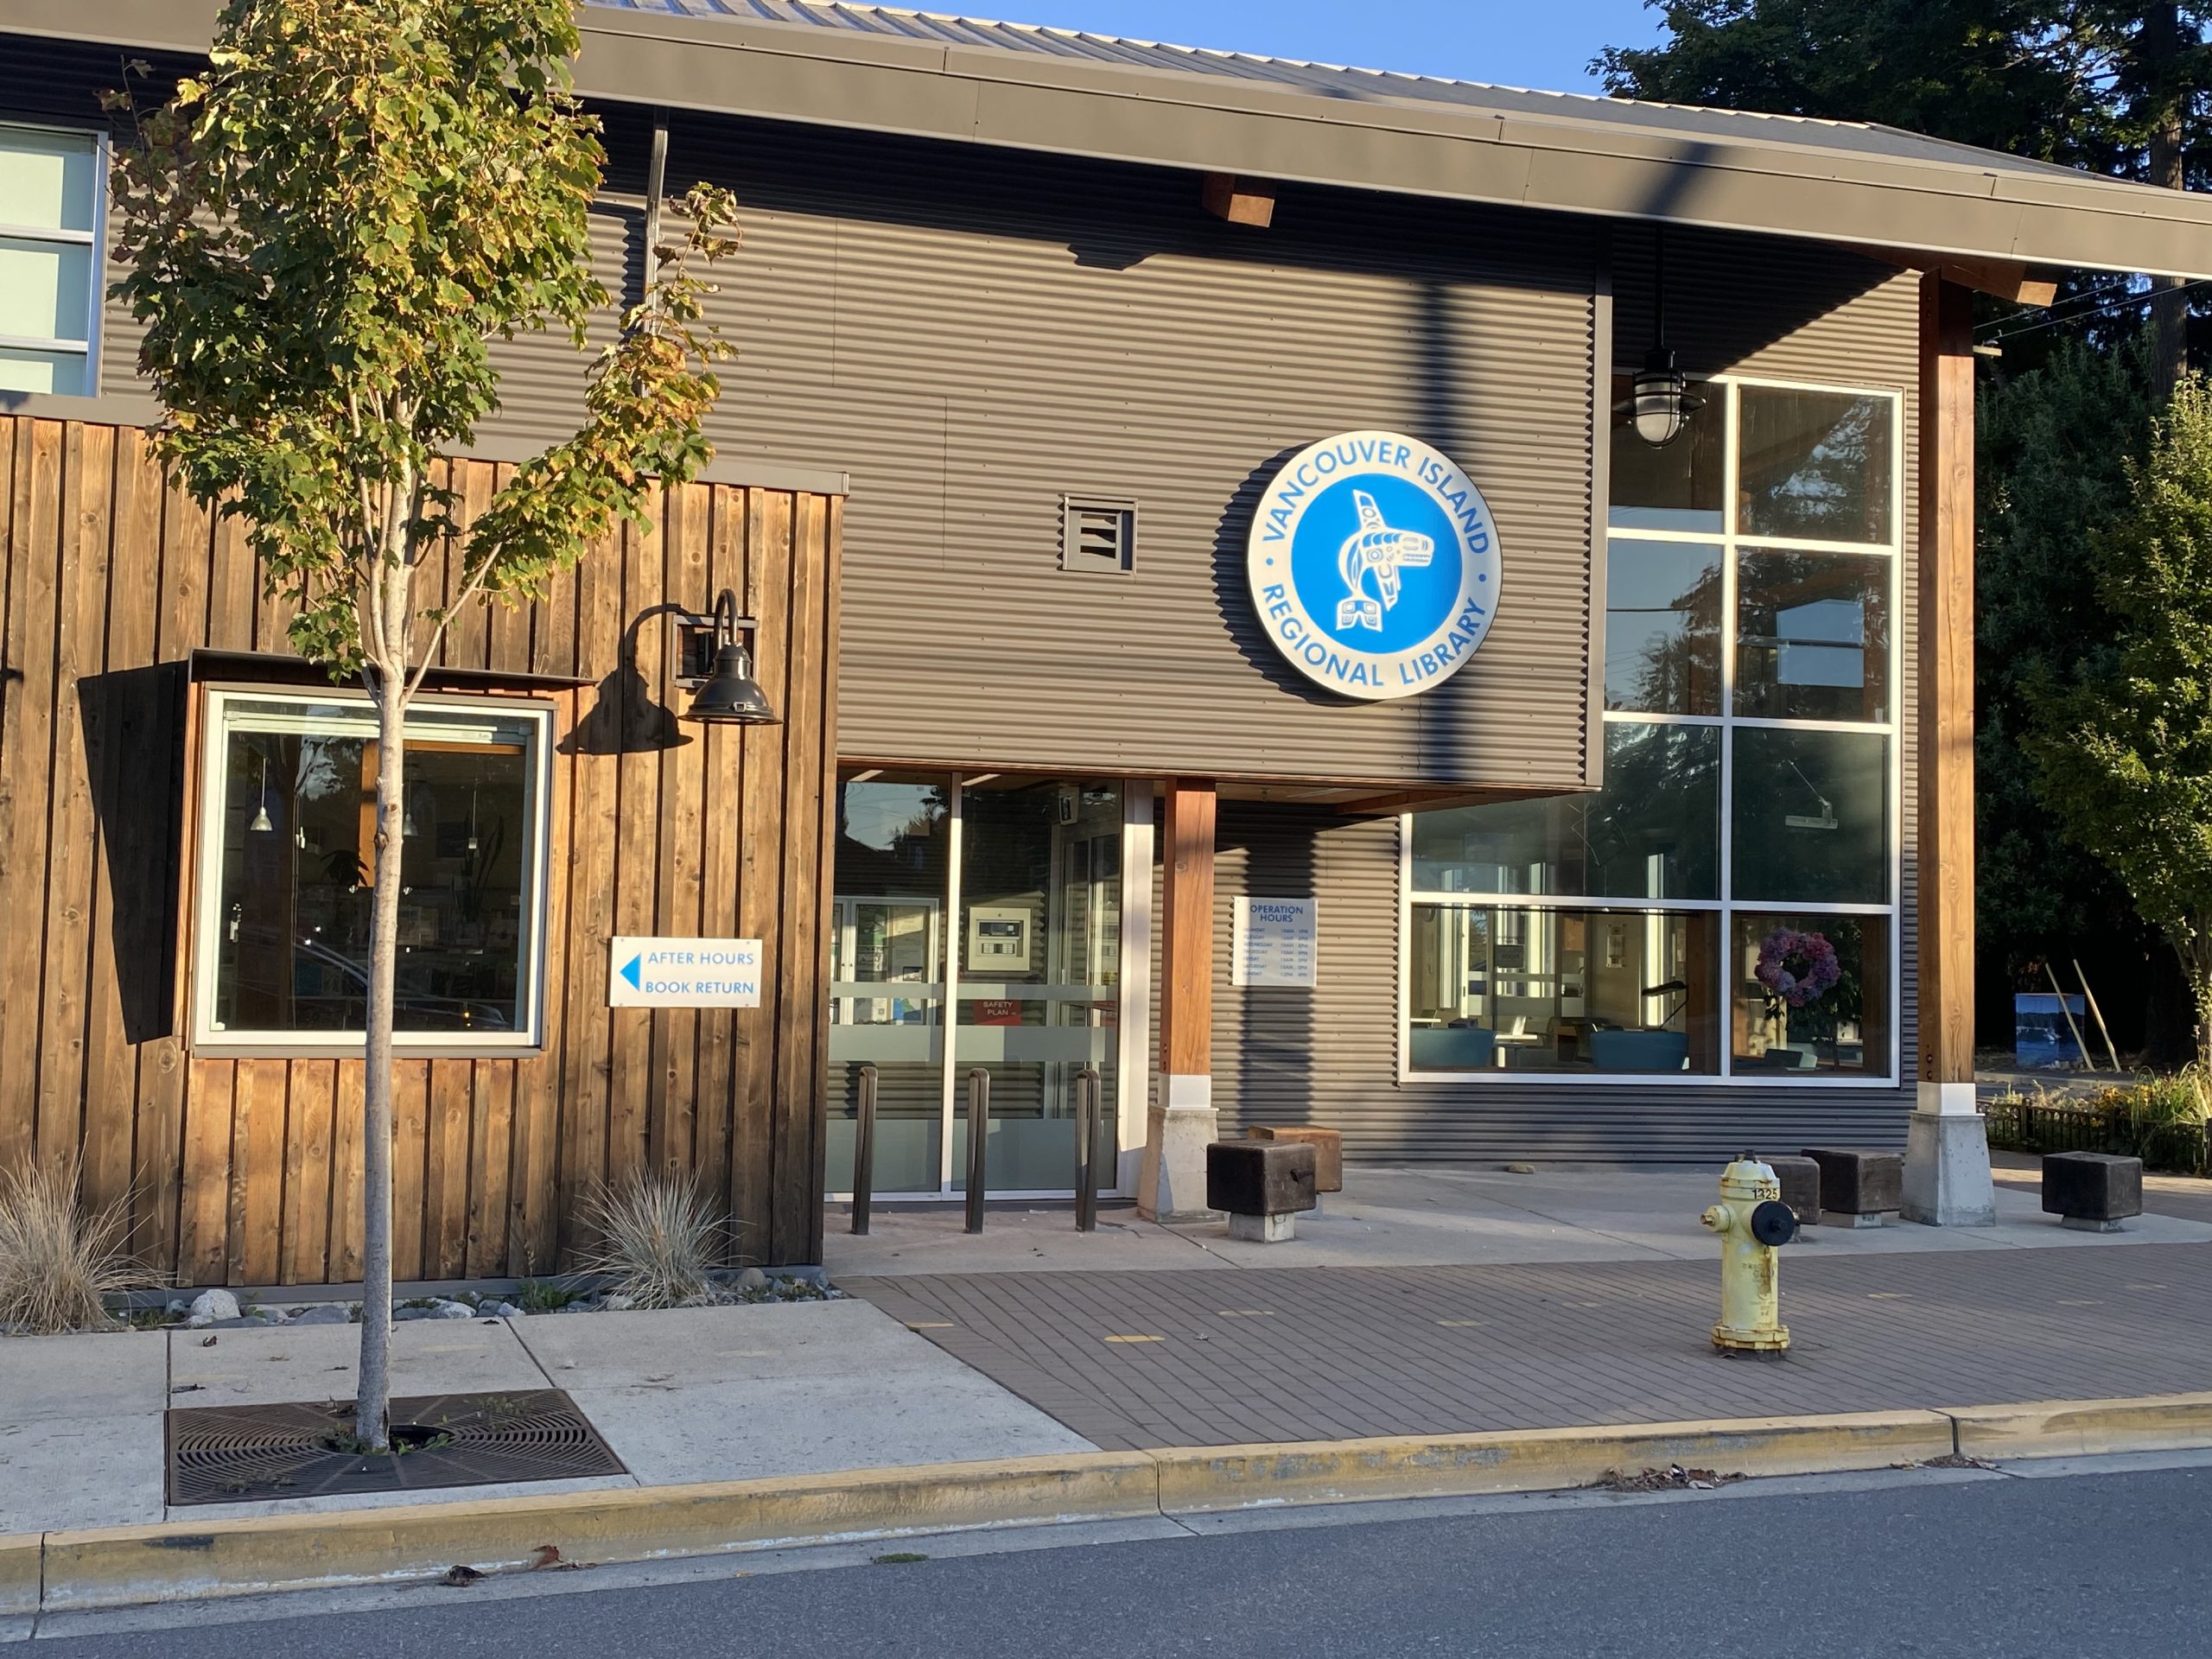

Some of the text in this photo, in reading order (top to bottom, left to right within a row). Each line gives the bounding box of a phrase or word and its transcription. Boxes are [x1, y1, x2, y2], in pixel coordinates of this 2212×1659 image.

[1262, 440, 1490, 554] VANCOUVER ISLAND
[1262, 583, 1486, 686] REGIONAL LIBRARY
[1249, 905, 1303, 914] OPERATION
[1260, 913, 1294, 923] HOURS
[648, 951, 753, 965] AFTER HOURS
[645, 981, 753, 994] BOOK RETURN
[1751, 1187, 1777, 1199] 1325
